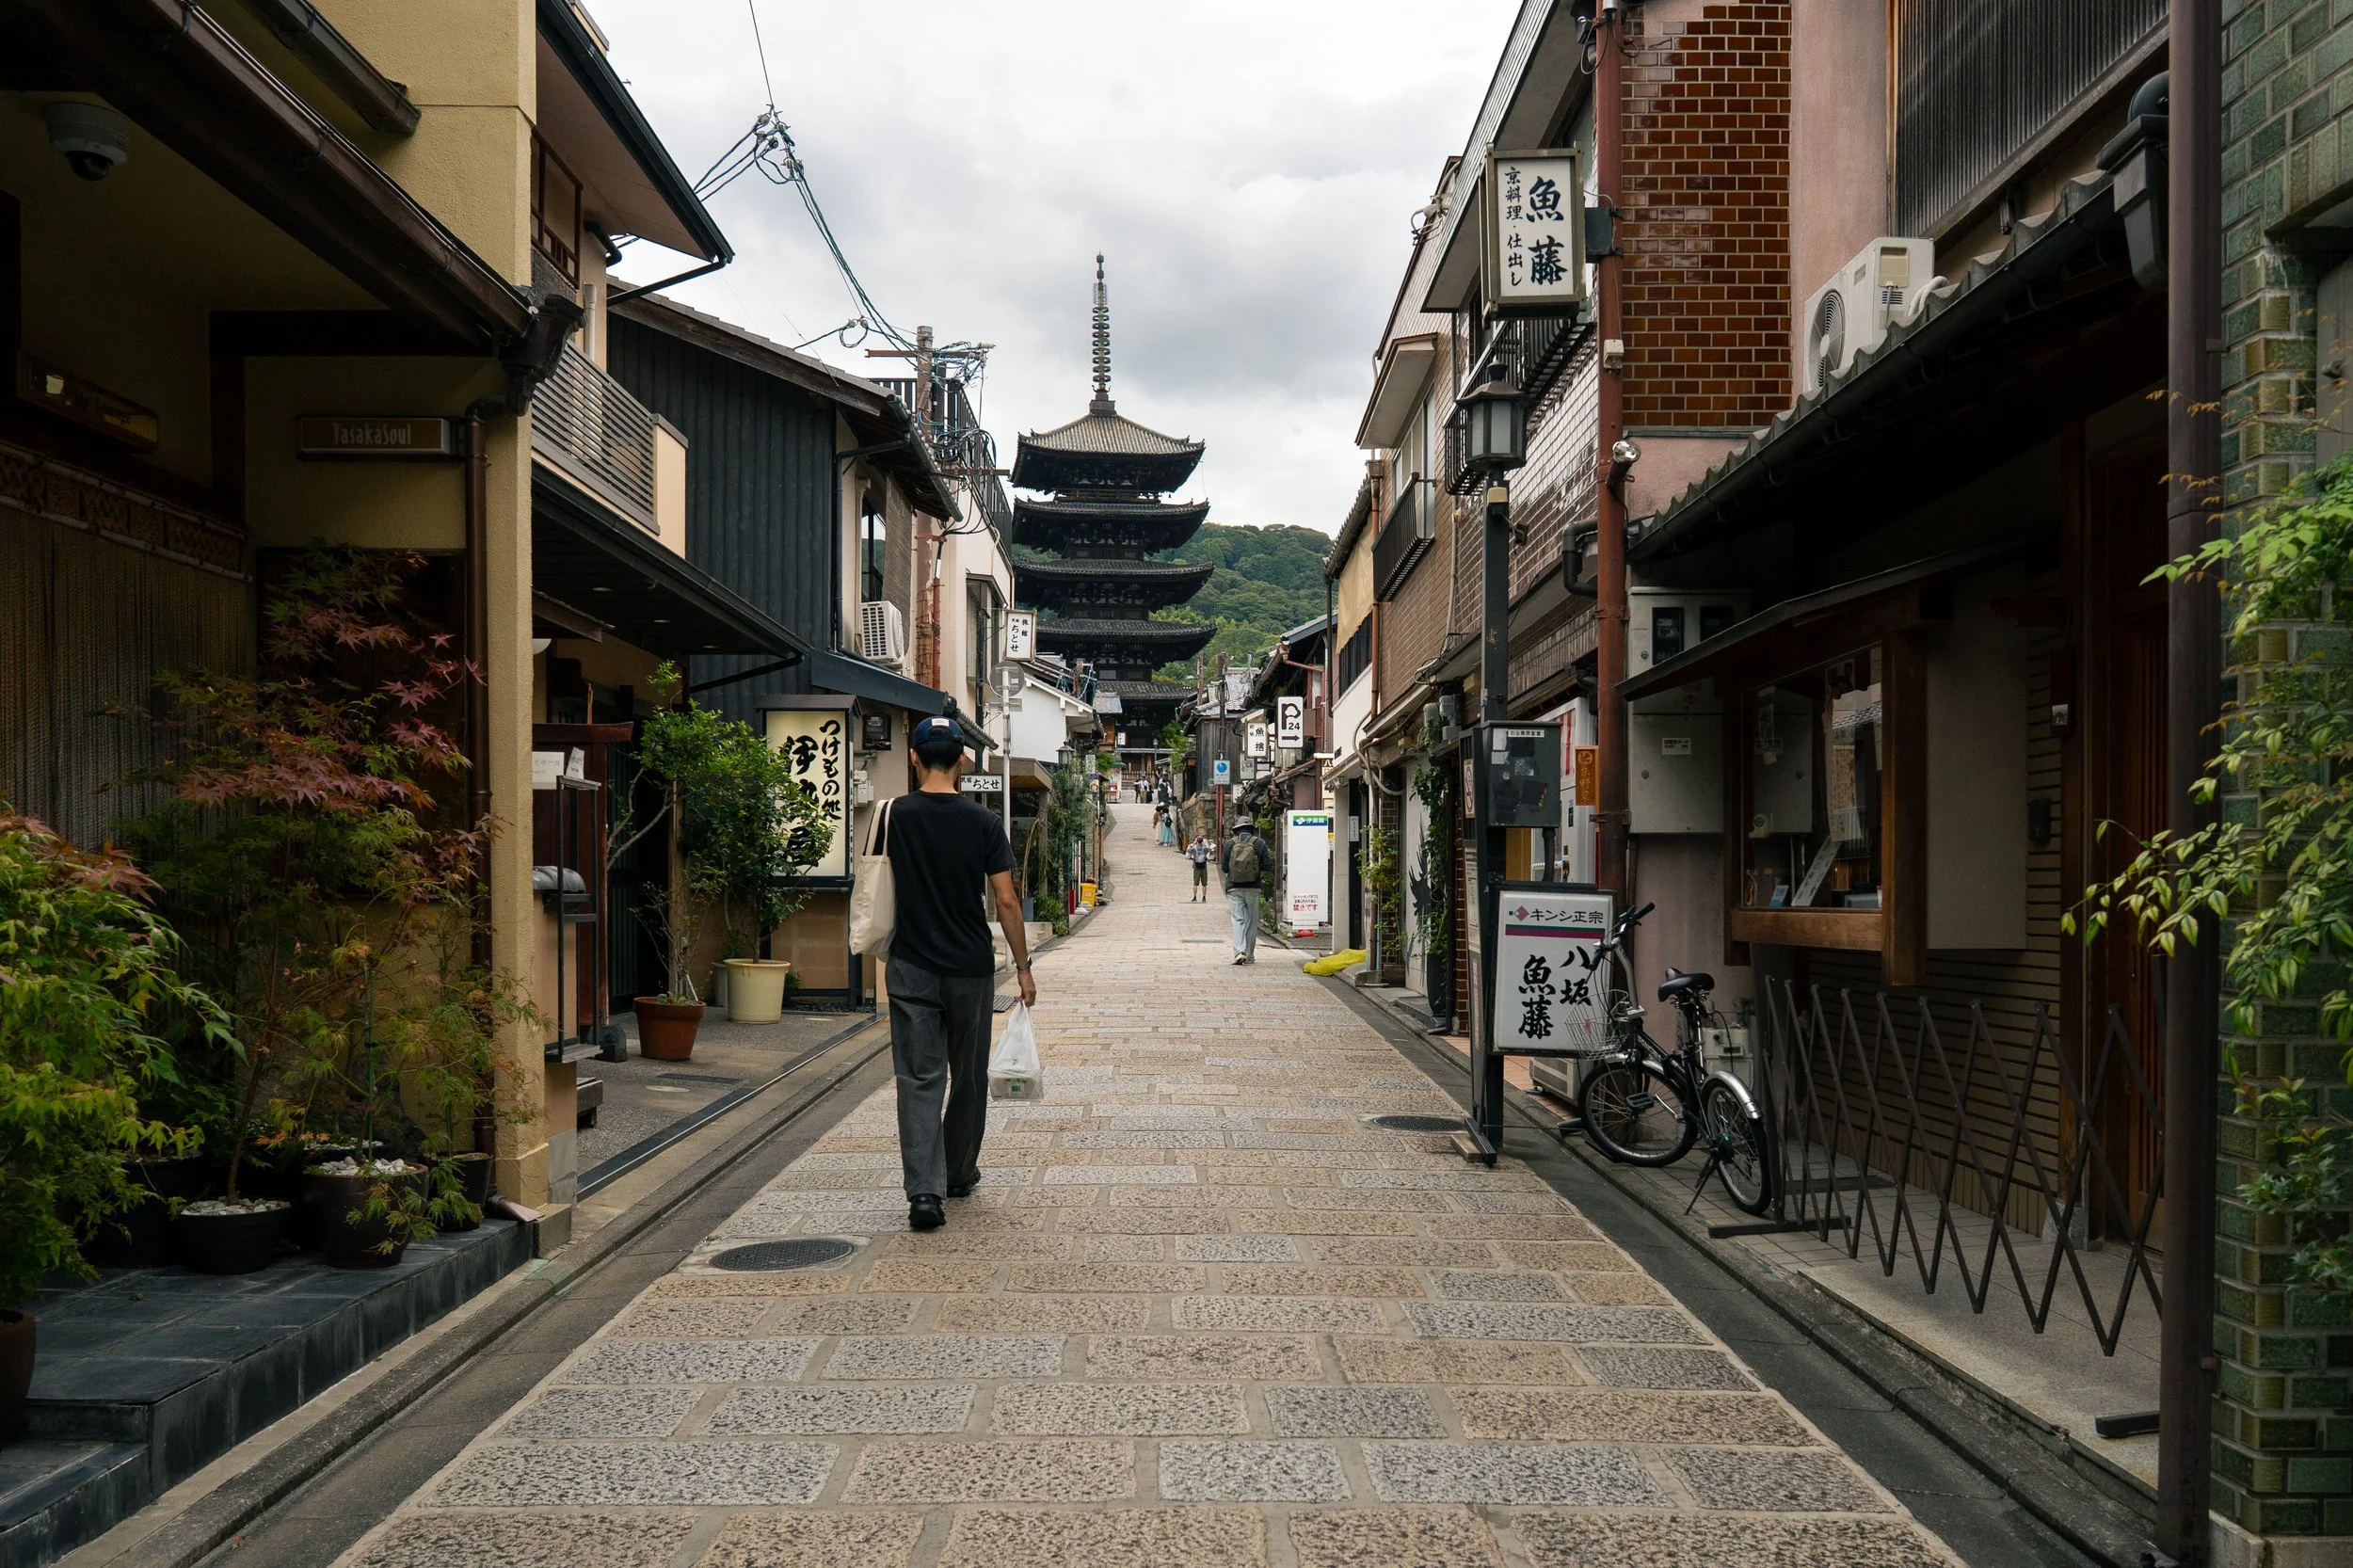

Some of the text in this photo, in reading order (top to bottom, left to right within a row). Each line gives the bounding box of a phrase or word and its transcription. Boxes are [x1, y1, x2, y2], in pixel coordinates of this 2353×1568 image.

[1504, 166, 1523, 287] 京料理・仕出し
[1526, 175, 1568, 286] 魚藤
[331, 423, 412, 446] YasakaSoul
[1288, 722, 1301, 730] 24
[972, 778, 1000, 791] ちとせ
[1530, 908, 1604, 924] キンシ正宗
[1518, 953, 1556, 1040] 魚藤
[1559, 945, 1593, 1006] 八坂
